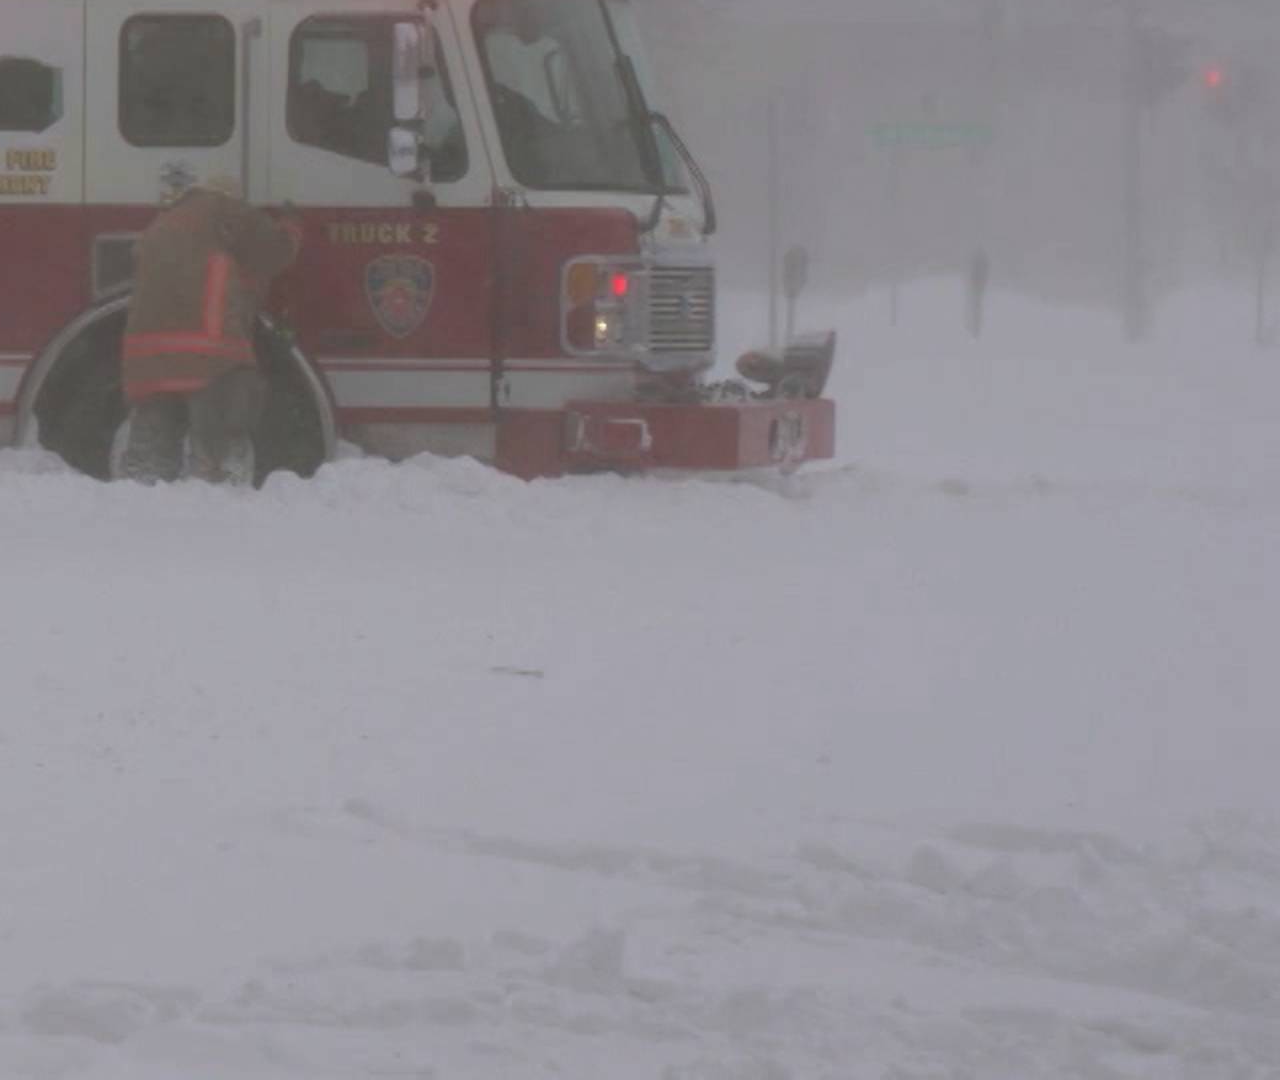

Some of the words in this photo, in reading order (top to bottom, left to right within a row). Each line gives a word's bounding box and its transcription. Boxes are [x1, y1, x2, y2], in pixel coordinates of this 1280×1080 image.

[5, 149, 57, 170] FIRE
[328, 223, 411, 244] TRUCK
[422, 223, 440, 243] 2
